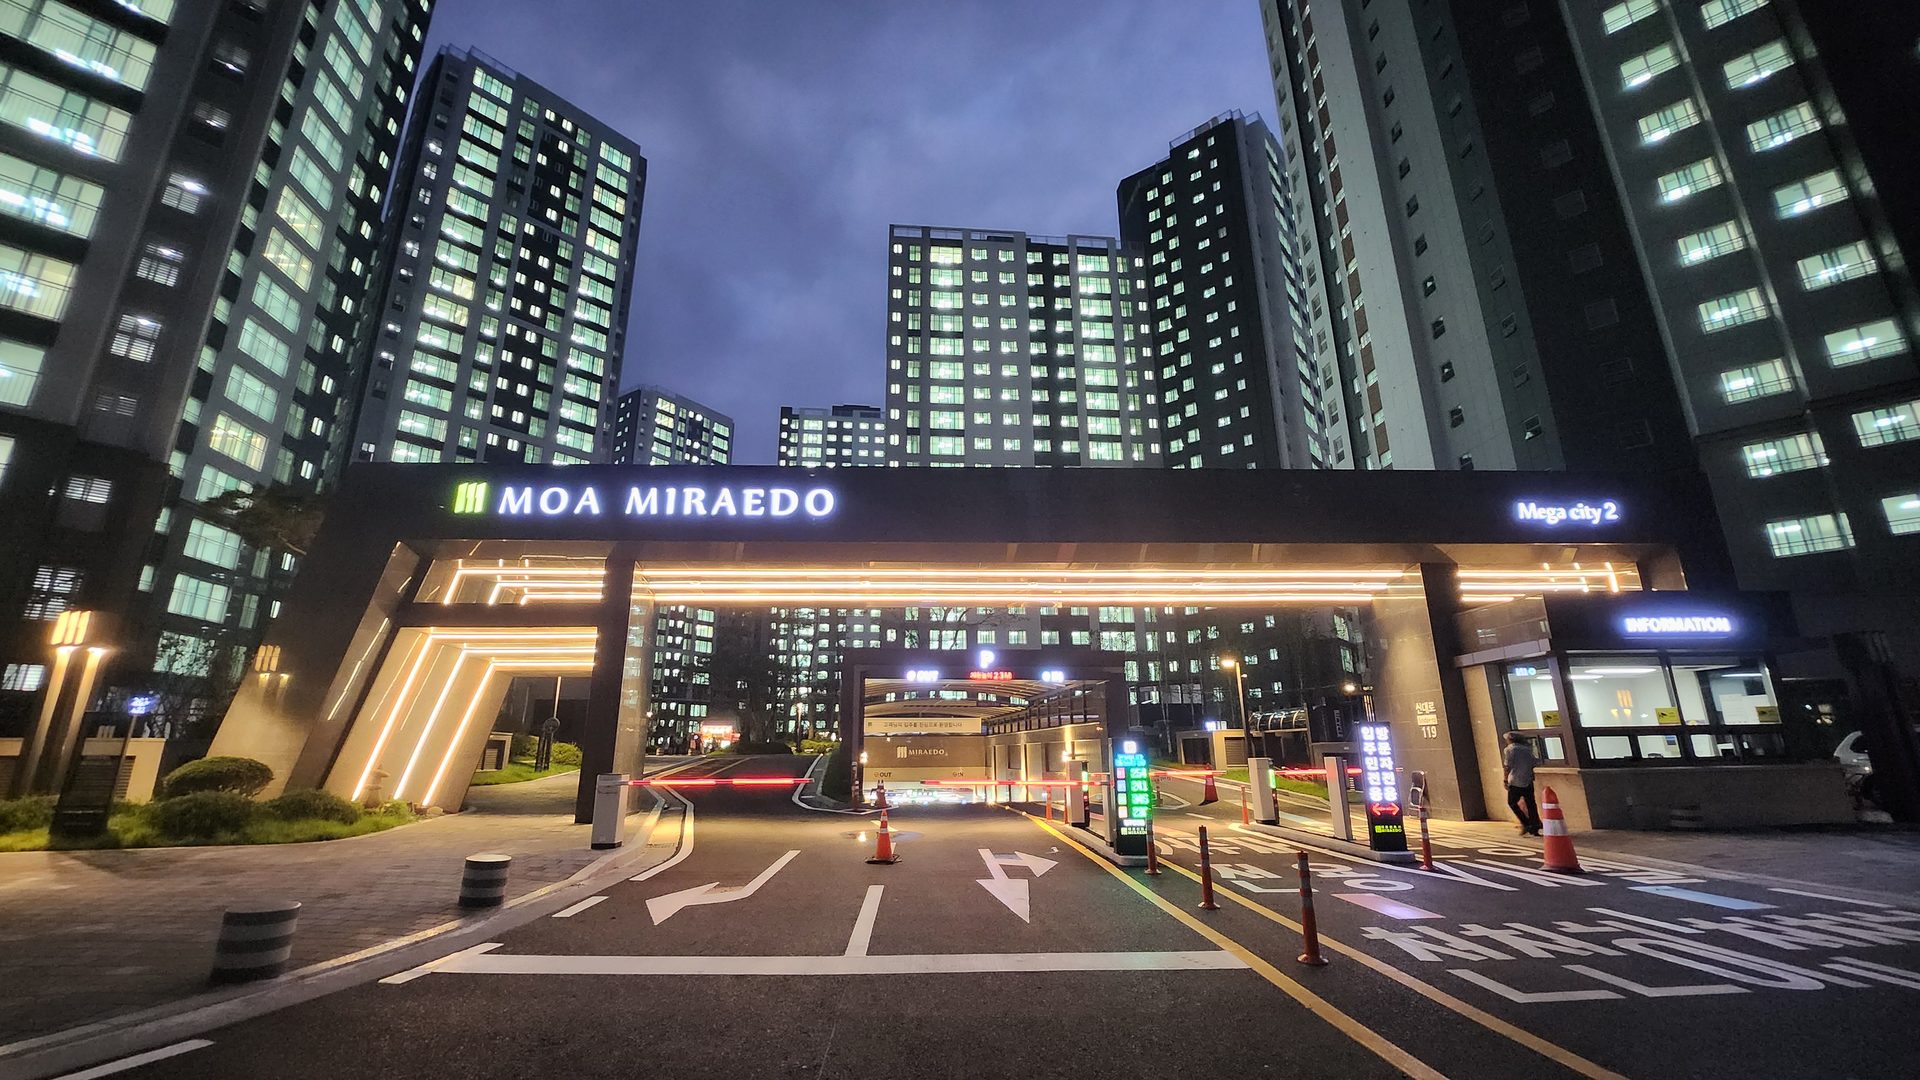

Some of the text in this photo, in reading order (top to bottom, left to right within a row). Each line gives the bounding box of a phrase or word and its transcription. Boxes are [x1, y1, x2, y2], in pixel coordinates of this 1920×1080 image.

[498, 487, 835, 517] MOA MIRAEDO
[1518, 501, 1619, 525] Mega city 2
[1625, 617, 1732, 633] INFORMATION
[979, 650, 995, 669] P
[1421, 725, 1437, 738] 119
[1361, 920, 1872, 1004] 천천히
